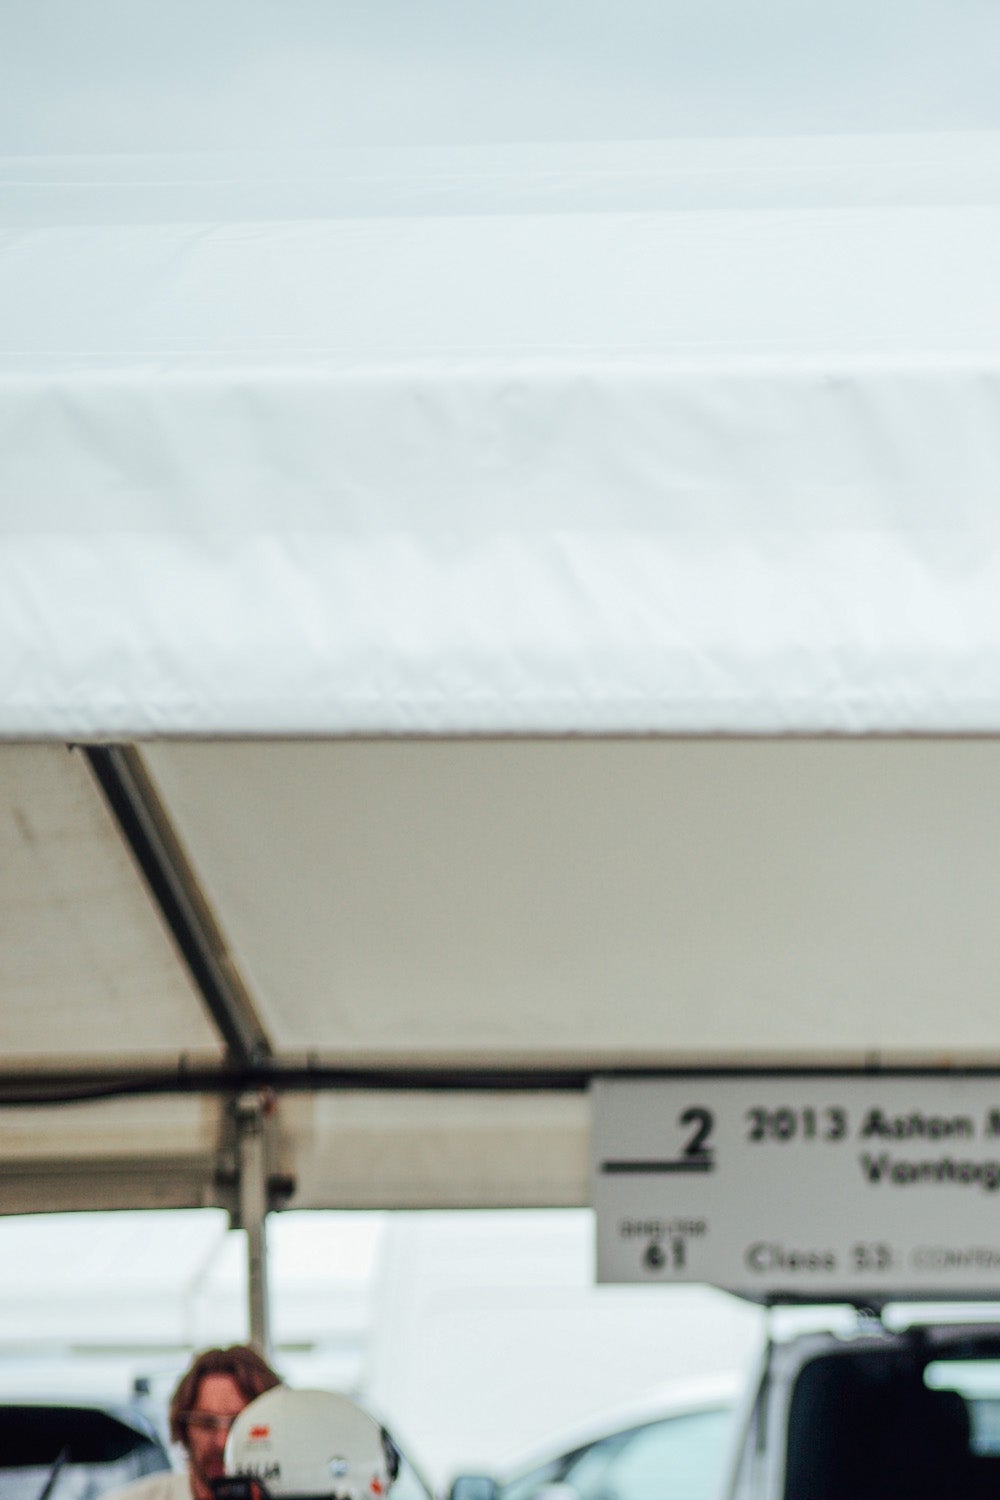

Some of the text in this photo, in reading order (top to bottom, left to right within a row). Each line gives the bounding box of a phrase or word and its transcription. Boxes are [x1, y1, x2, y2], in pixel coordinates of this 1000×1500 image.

[680, 1107, 715, 1157] 2
[746, 1107, 847, 1140] 2013
[860, 1107, 973, 1140] Aston
[643, 1241, 686, 1270] 61
[745, 1244, 837, 1270] Class
